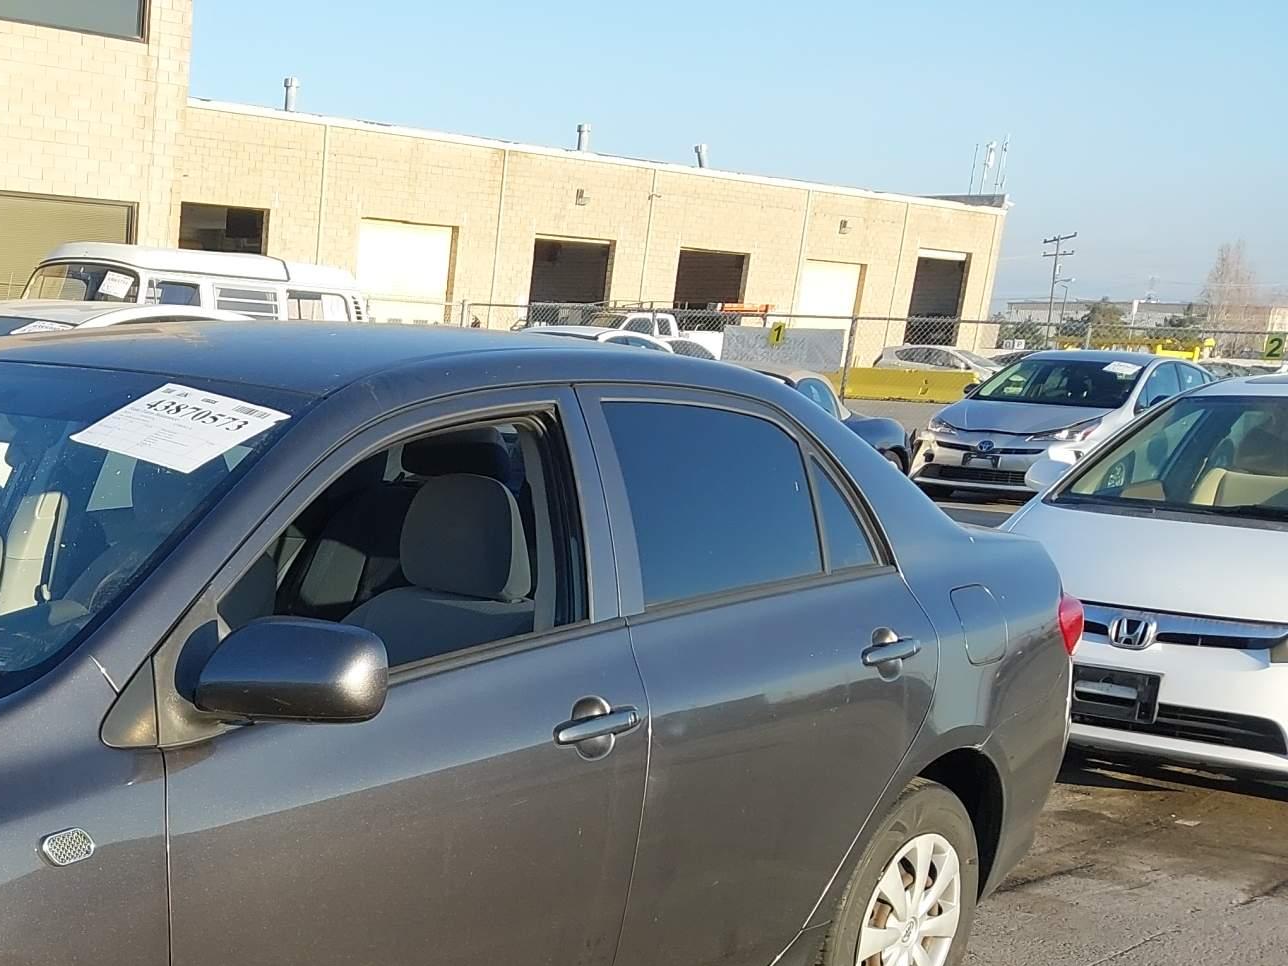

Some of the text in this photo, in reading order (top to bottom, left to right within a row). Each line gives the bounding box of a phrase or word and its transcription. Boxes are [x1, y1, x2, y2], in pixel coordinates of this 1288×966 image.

[773, 325, 783, 342] 1
[1266, 338, 1283, 357] 2
[146, 399, 249, 431] 43870573
